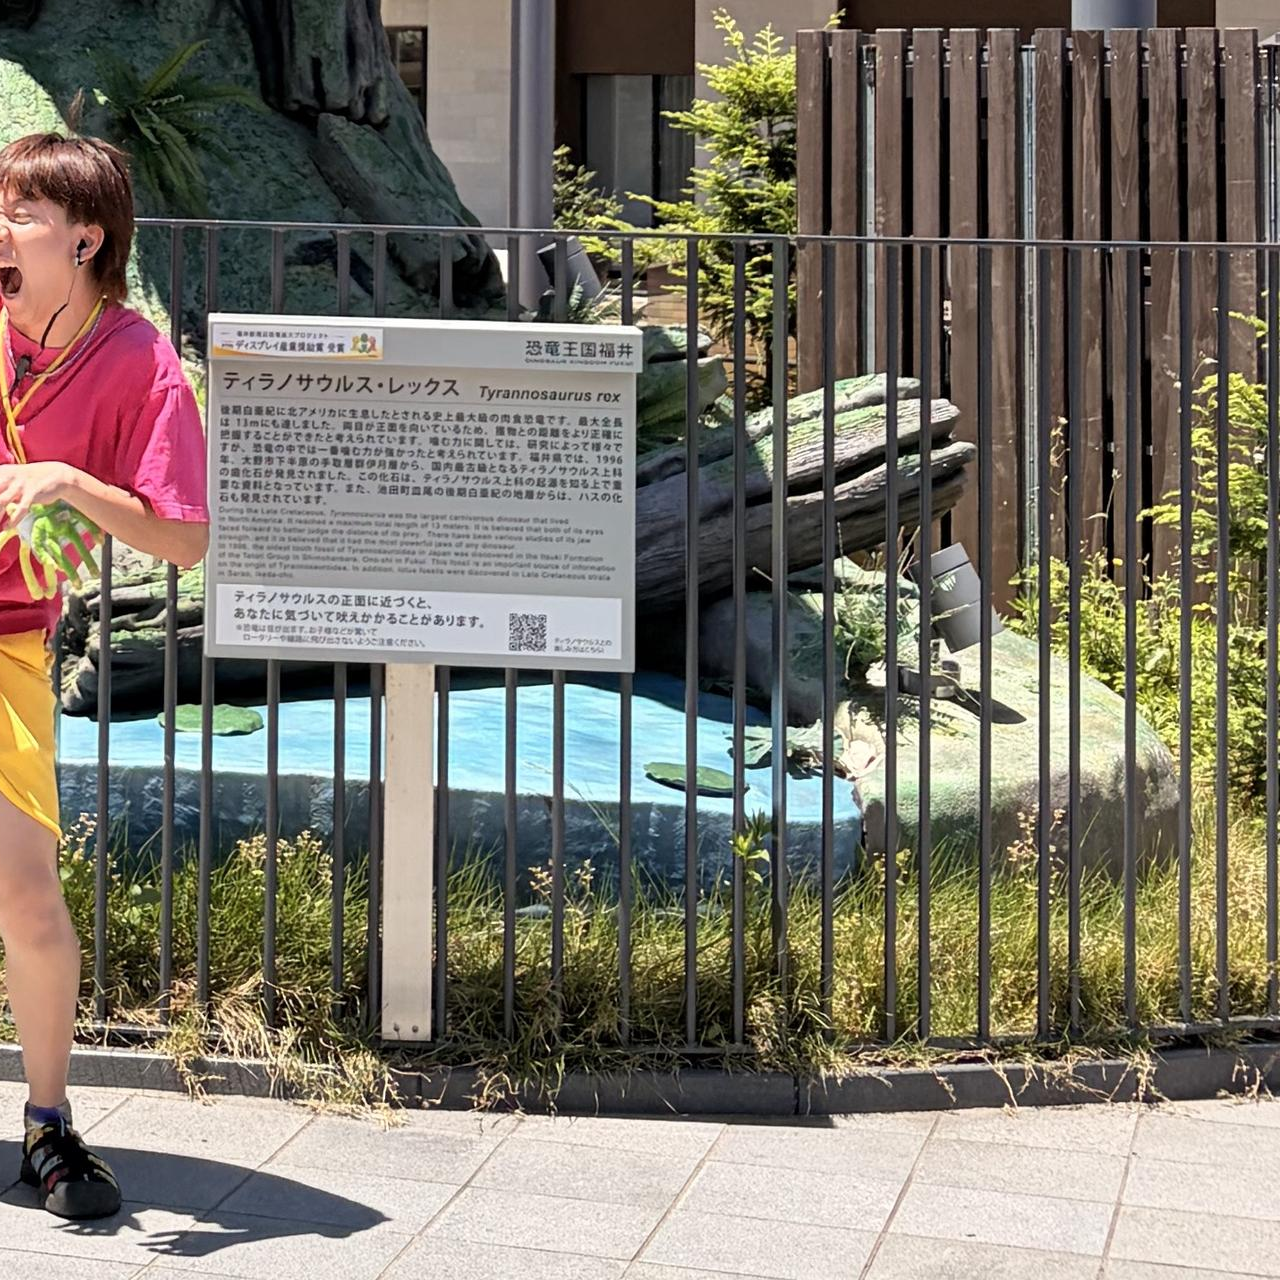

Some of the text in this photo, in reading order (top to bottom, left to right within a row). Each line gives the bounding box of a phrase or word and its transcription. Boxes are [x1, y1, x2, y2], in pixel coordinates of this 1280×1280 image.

[526, 340, 633, 358] 恐竜王国福井
[223, 372, 460, 396] ティラノサウルス・レックス
[479, 386, 592, 401] Tyrannosaurus
[219, 492, 327, 506] 石も発見されています。
[234, 590, 432, 609] ティラノサウルスの正面に近づくと、
[234, 607, 484, 629] あなたに気づいて吠えかかることがあります。
